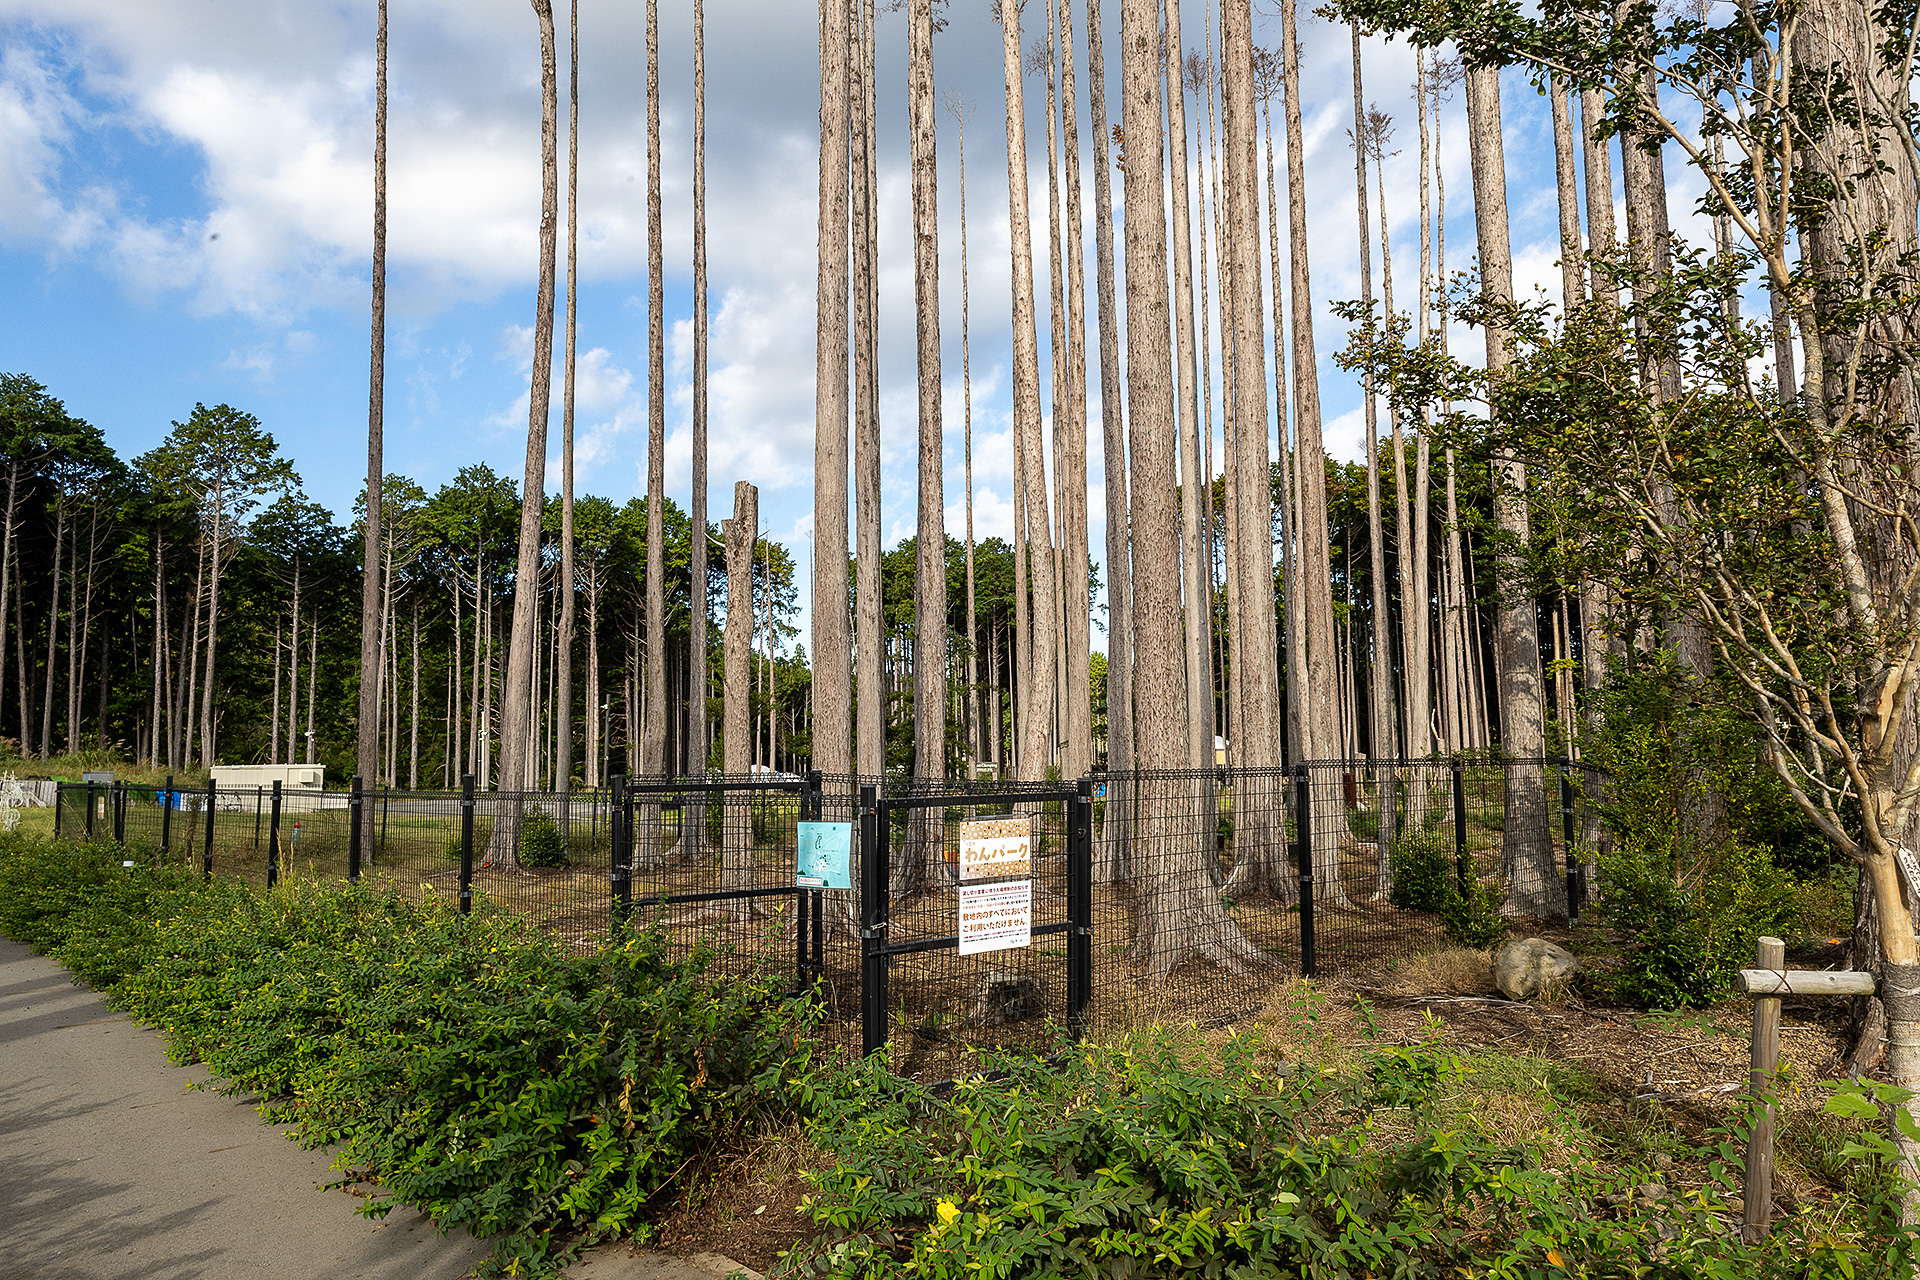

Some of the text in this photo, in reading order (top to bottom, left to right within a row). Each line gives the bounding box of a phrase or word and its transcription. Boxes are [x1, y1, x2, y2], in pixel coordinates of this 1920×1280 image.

[965, 843, 1028, 863] わんパーク
[962, 906, 1029, 922] 敷地内のすべてにおいて
